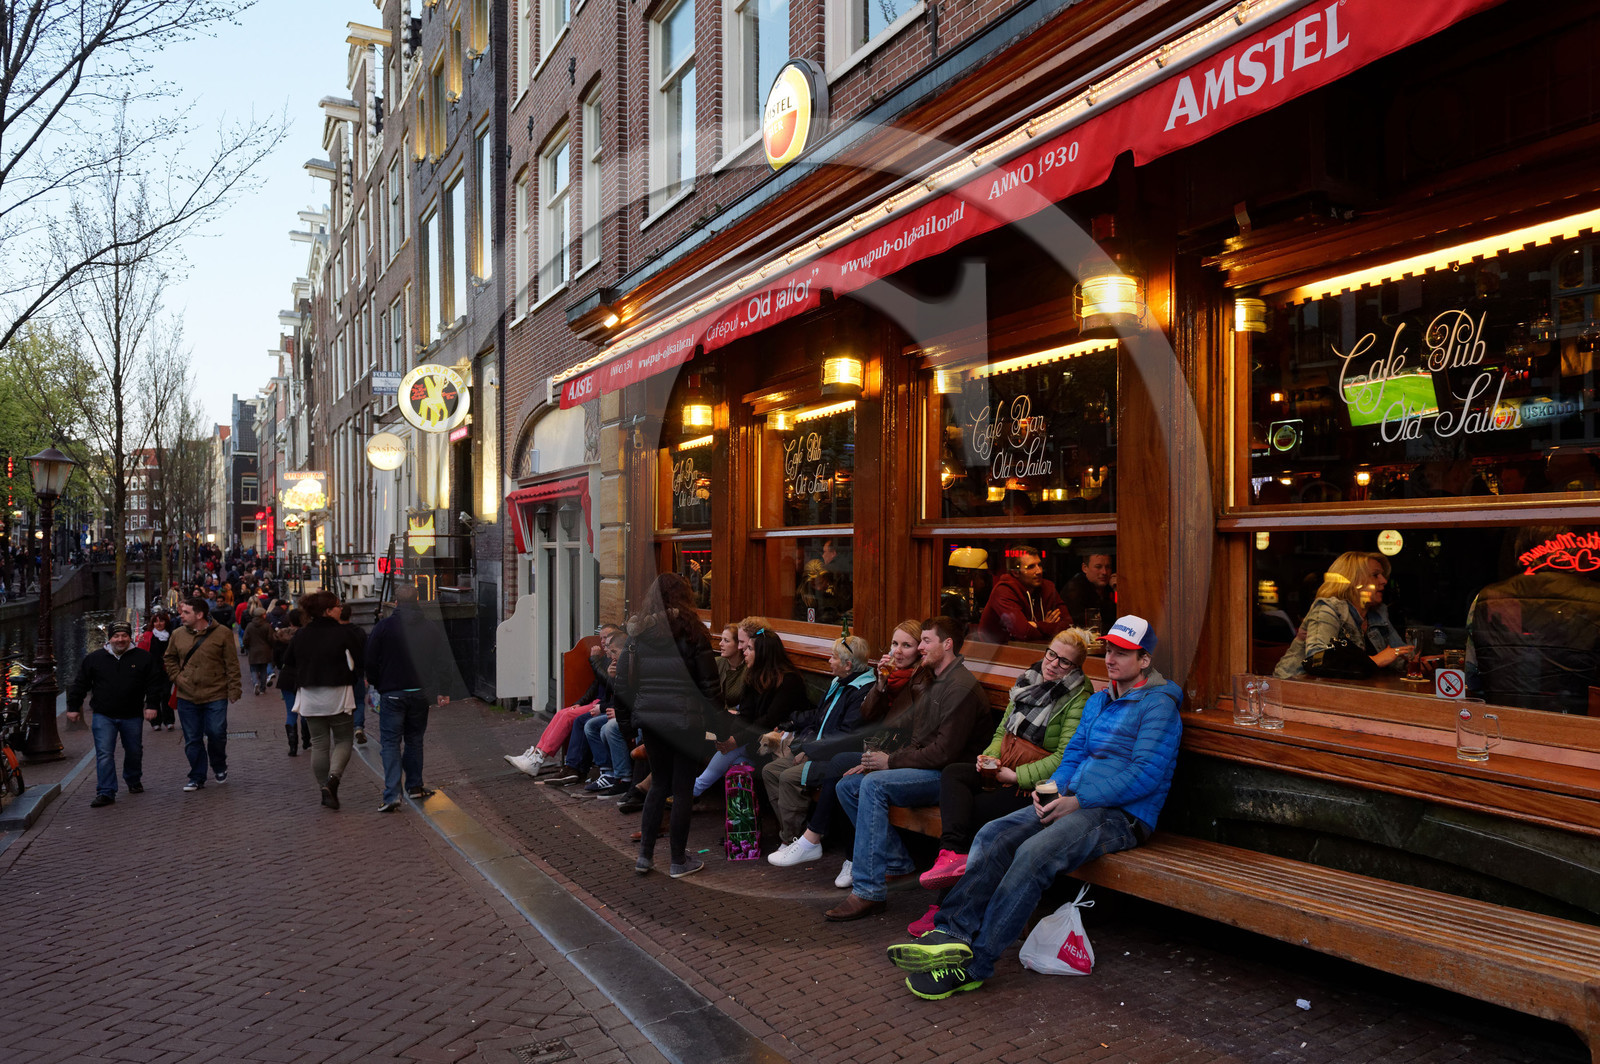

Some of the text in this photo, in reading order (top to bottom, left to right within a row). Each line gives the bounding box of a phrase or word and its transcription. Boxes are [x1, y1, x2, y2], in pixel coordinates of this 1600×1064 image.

[1163, 1, 1350, 132] AMSTEL
[988, 142, 1079, 200] ANNO 1930
[1331, 308, 1487, 414] Café Pub
[969, 394, 1045, 460] Café Bar
